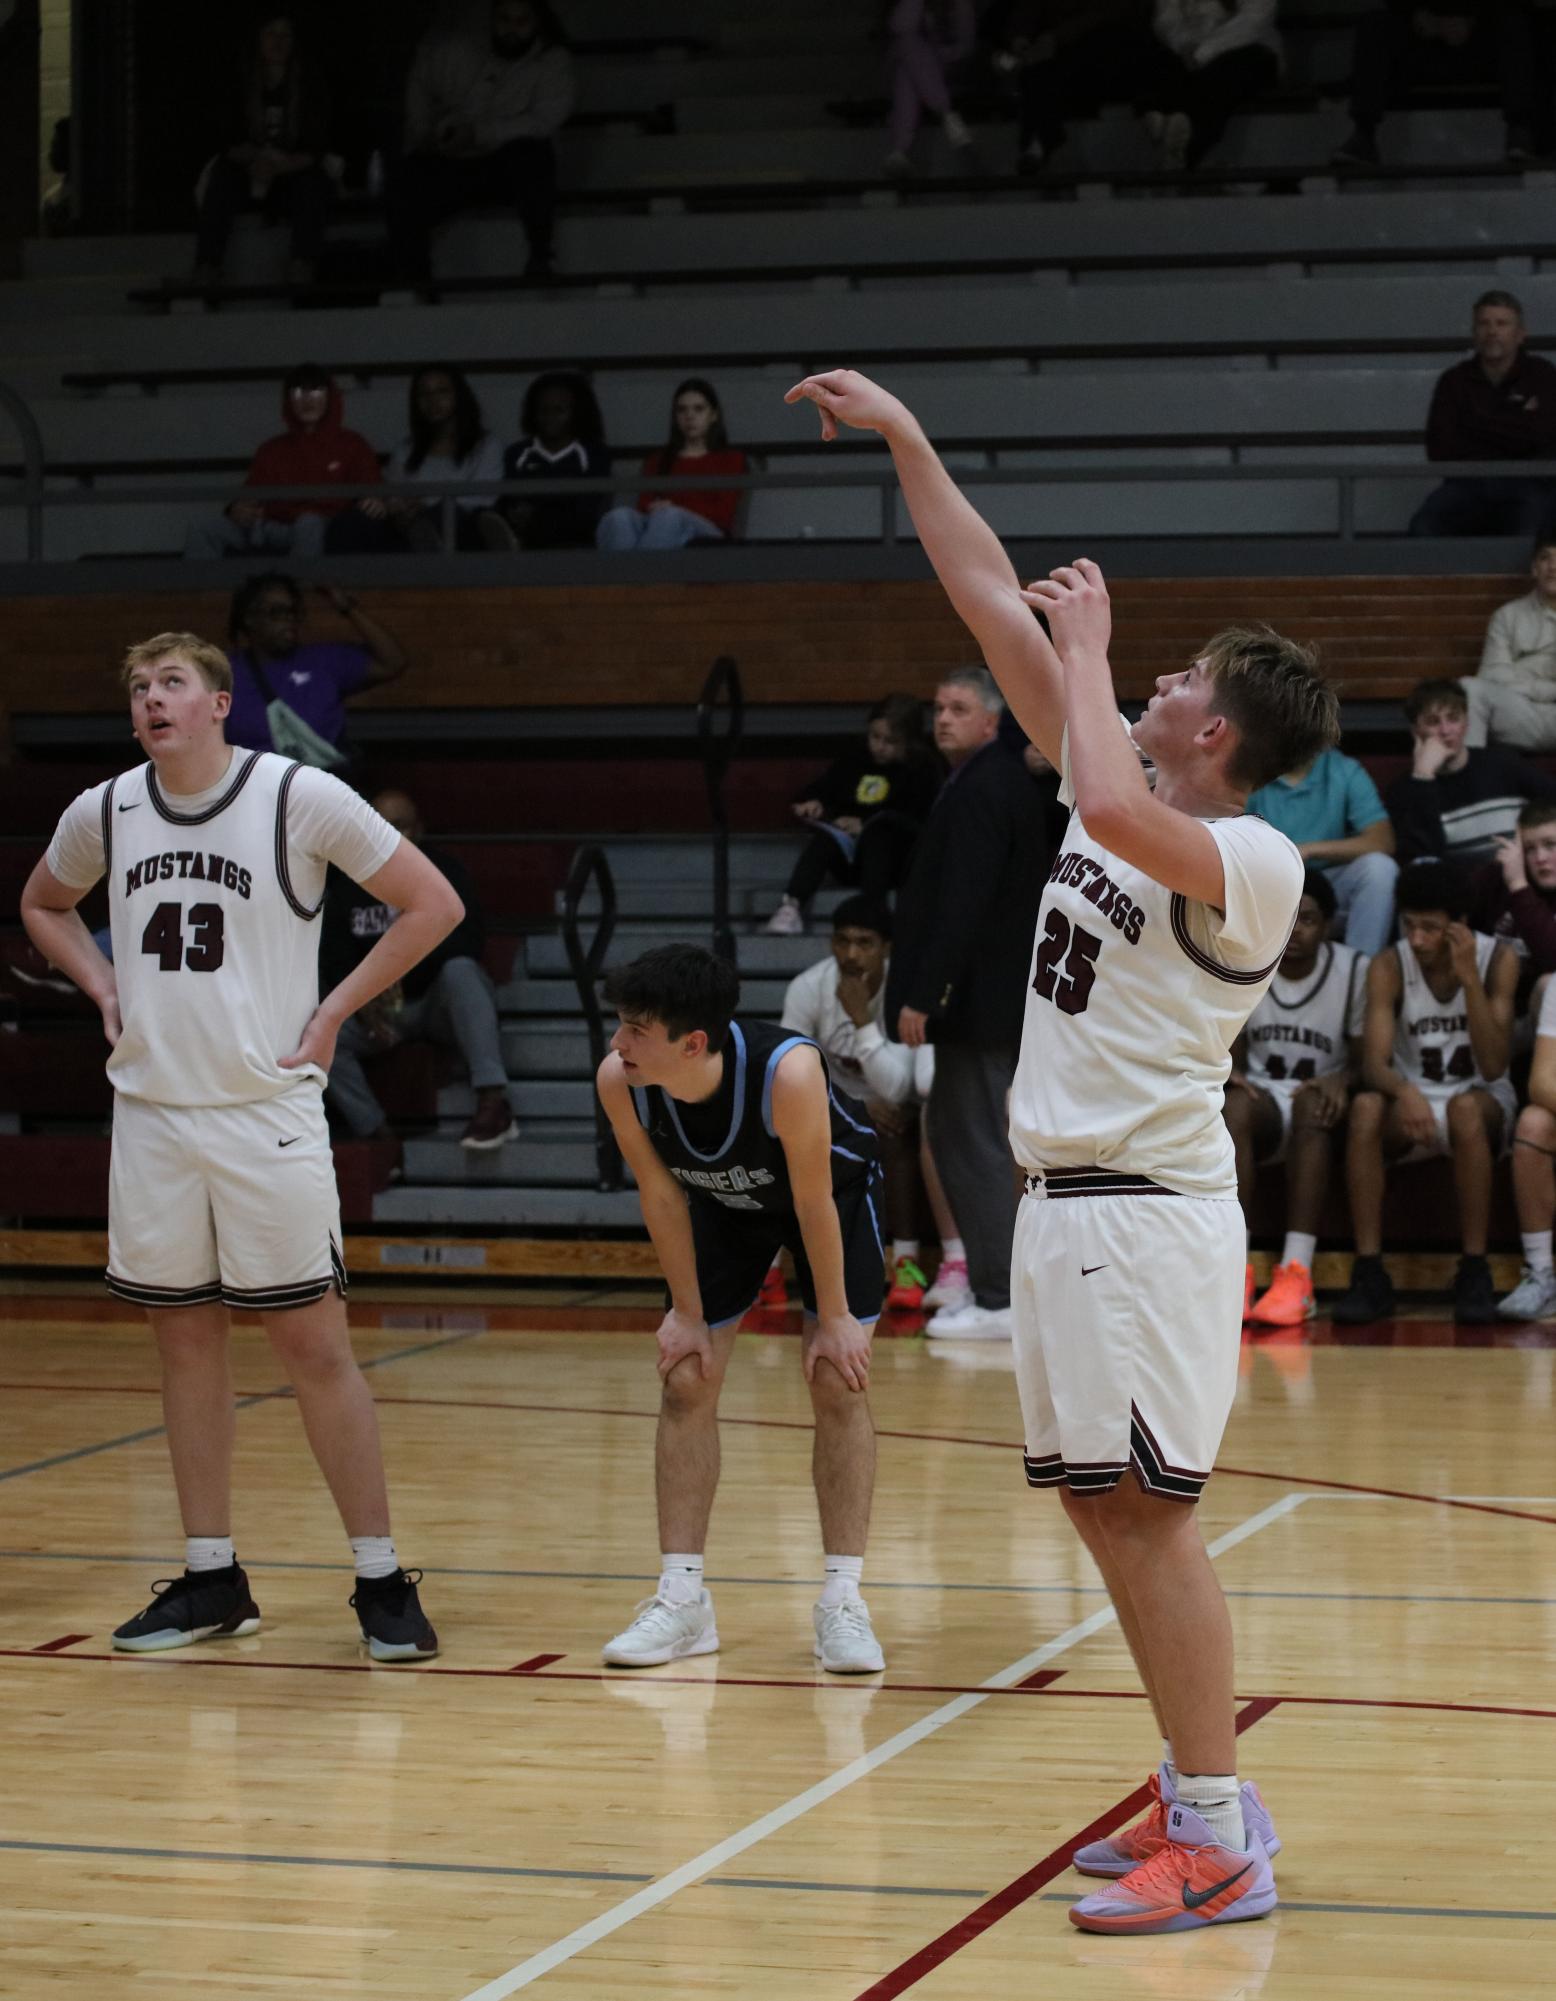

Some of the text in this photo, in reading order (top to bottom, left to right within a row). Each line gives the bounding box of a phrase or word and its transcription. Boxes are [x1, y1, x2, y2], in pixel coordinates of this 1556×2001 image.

[126, 851, 252, 900] MUSTANGS
[141, 902, 224, 972] 43
[1032, 907, 1102, 1016] 25
[1408, 1015, 1468, 1036] MUSTAN
